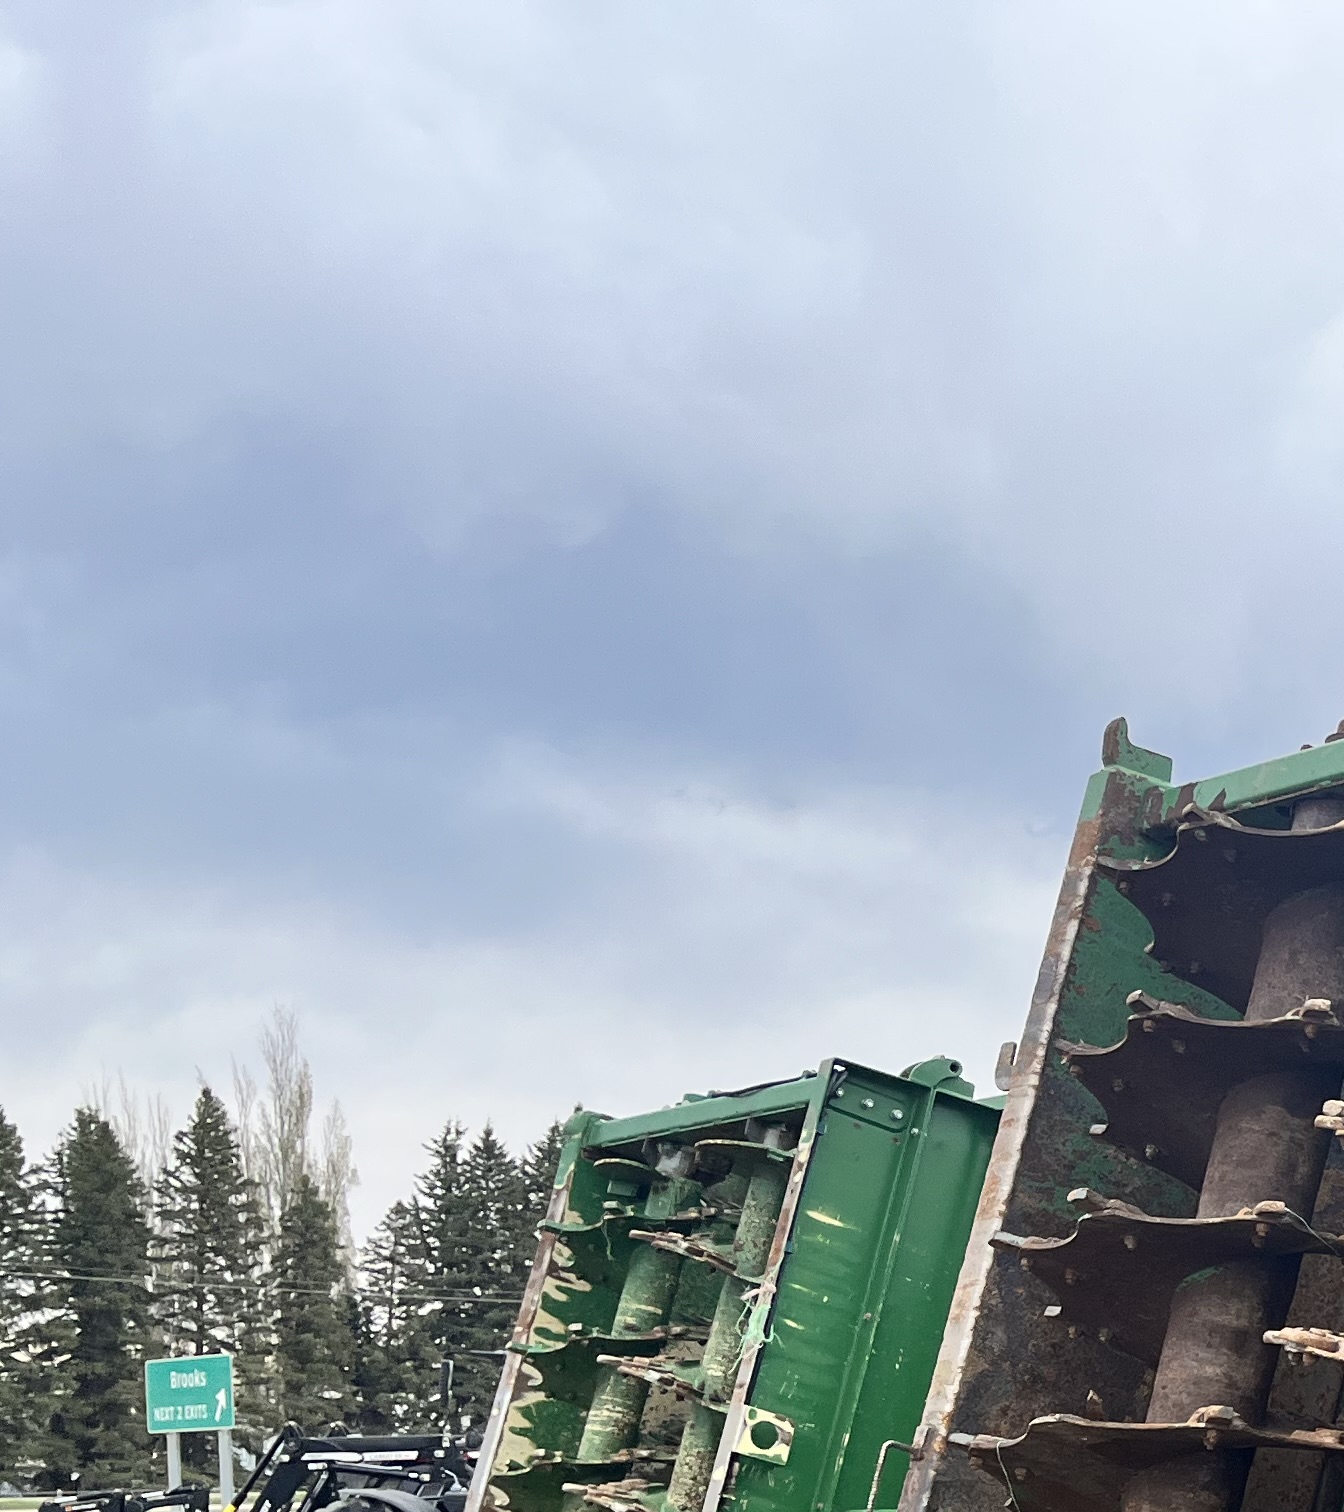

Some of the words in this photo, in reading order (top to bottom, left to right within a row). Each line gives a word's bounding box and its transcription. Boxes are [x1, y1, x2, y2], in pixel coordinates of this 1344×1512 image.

[169, 1368, 206, 1389] Brooks
[153, 1406, 175, 1421] NEXT
[176, 1406, 183, 1420] 2
[184, 1404, 208, 1420] EXITS
